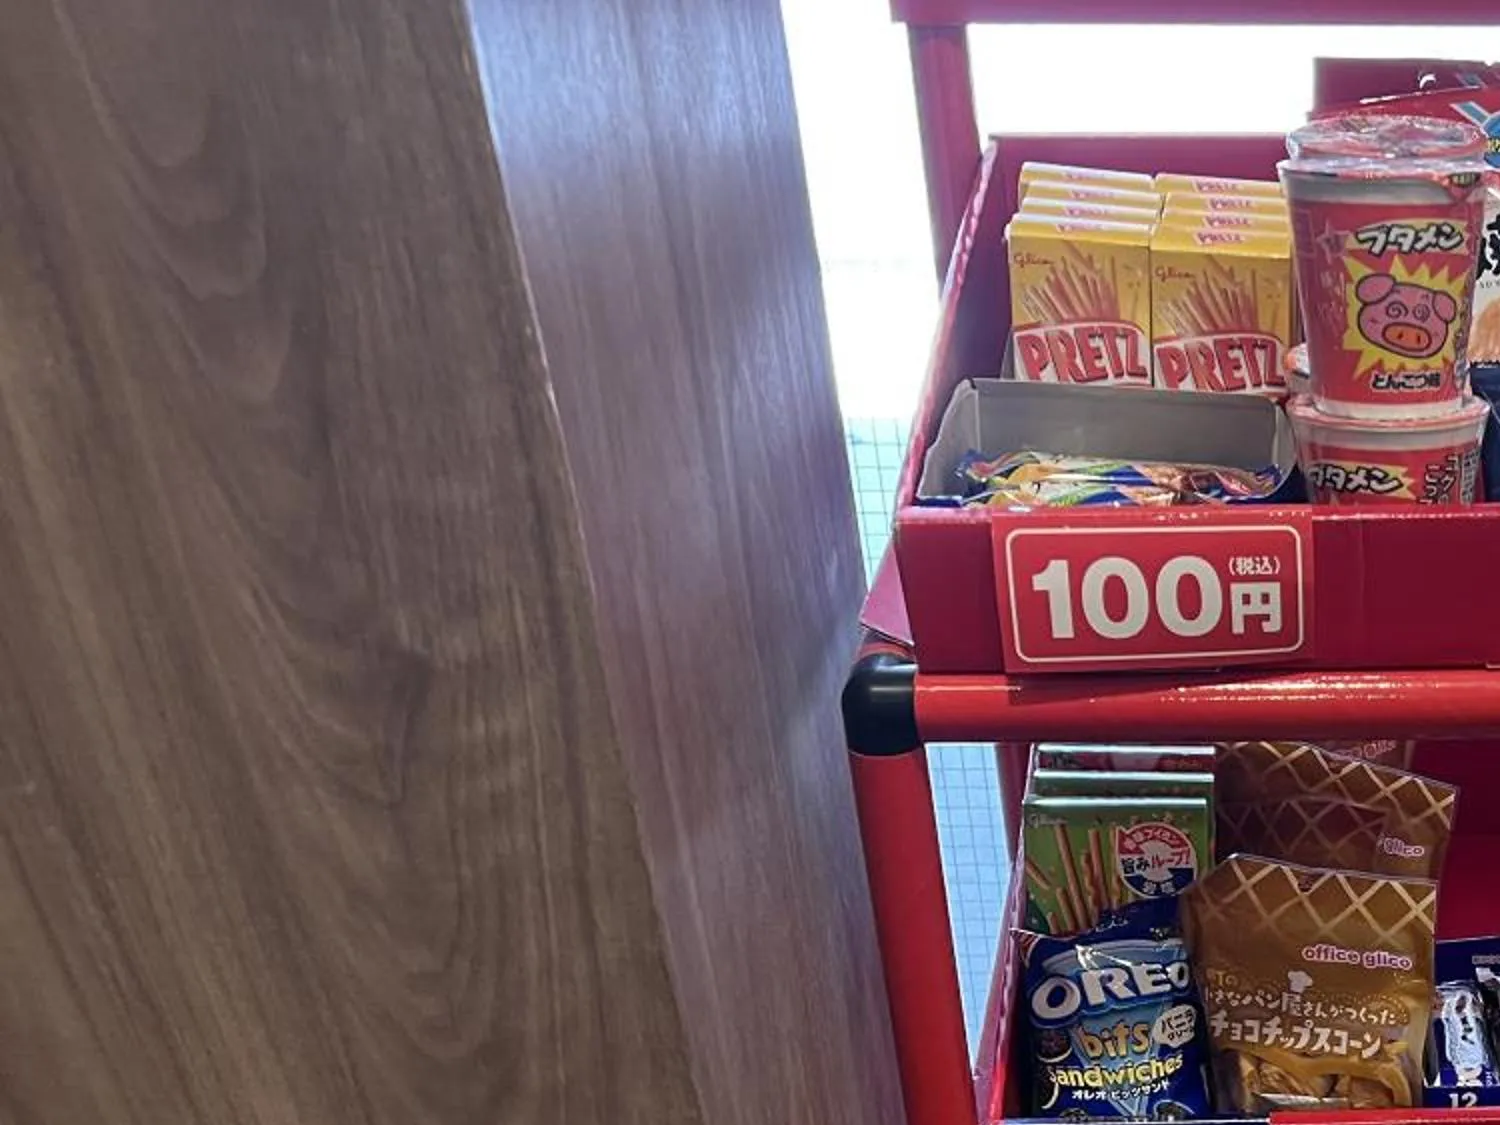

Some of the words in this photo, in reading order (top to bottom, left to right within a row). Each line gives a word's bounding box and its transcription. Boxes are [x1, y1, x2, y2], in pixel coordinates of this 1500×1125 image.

[1356, 221, 1465, 258] ブタメン
[1014, 252, 1053, 268] Glico
[1156, 264, 1195, 283] Glico
[1014, 325, 1149, 384] PRETZ
[1154, 336, 1287, 393] PRETZ
[1303, 945, 1360, 964] office
[1363, 951, 1412, 970] glico
[1031, 961, 1190, 1020] OREO
[1077, 1019, 1150, 1059] bits
[1209, 1011, 1382, 1060] チョコチップスコーン
[1450, 1092, 1478, 1109] 12
